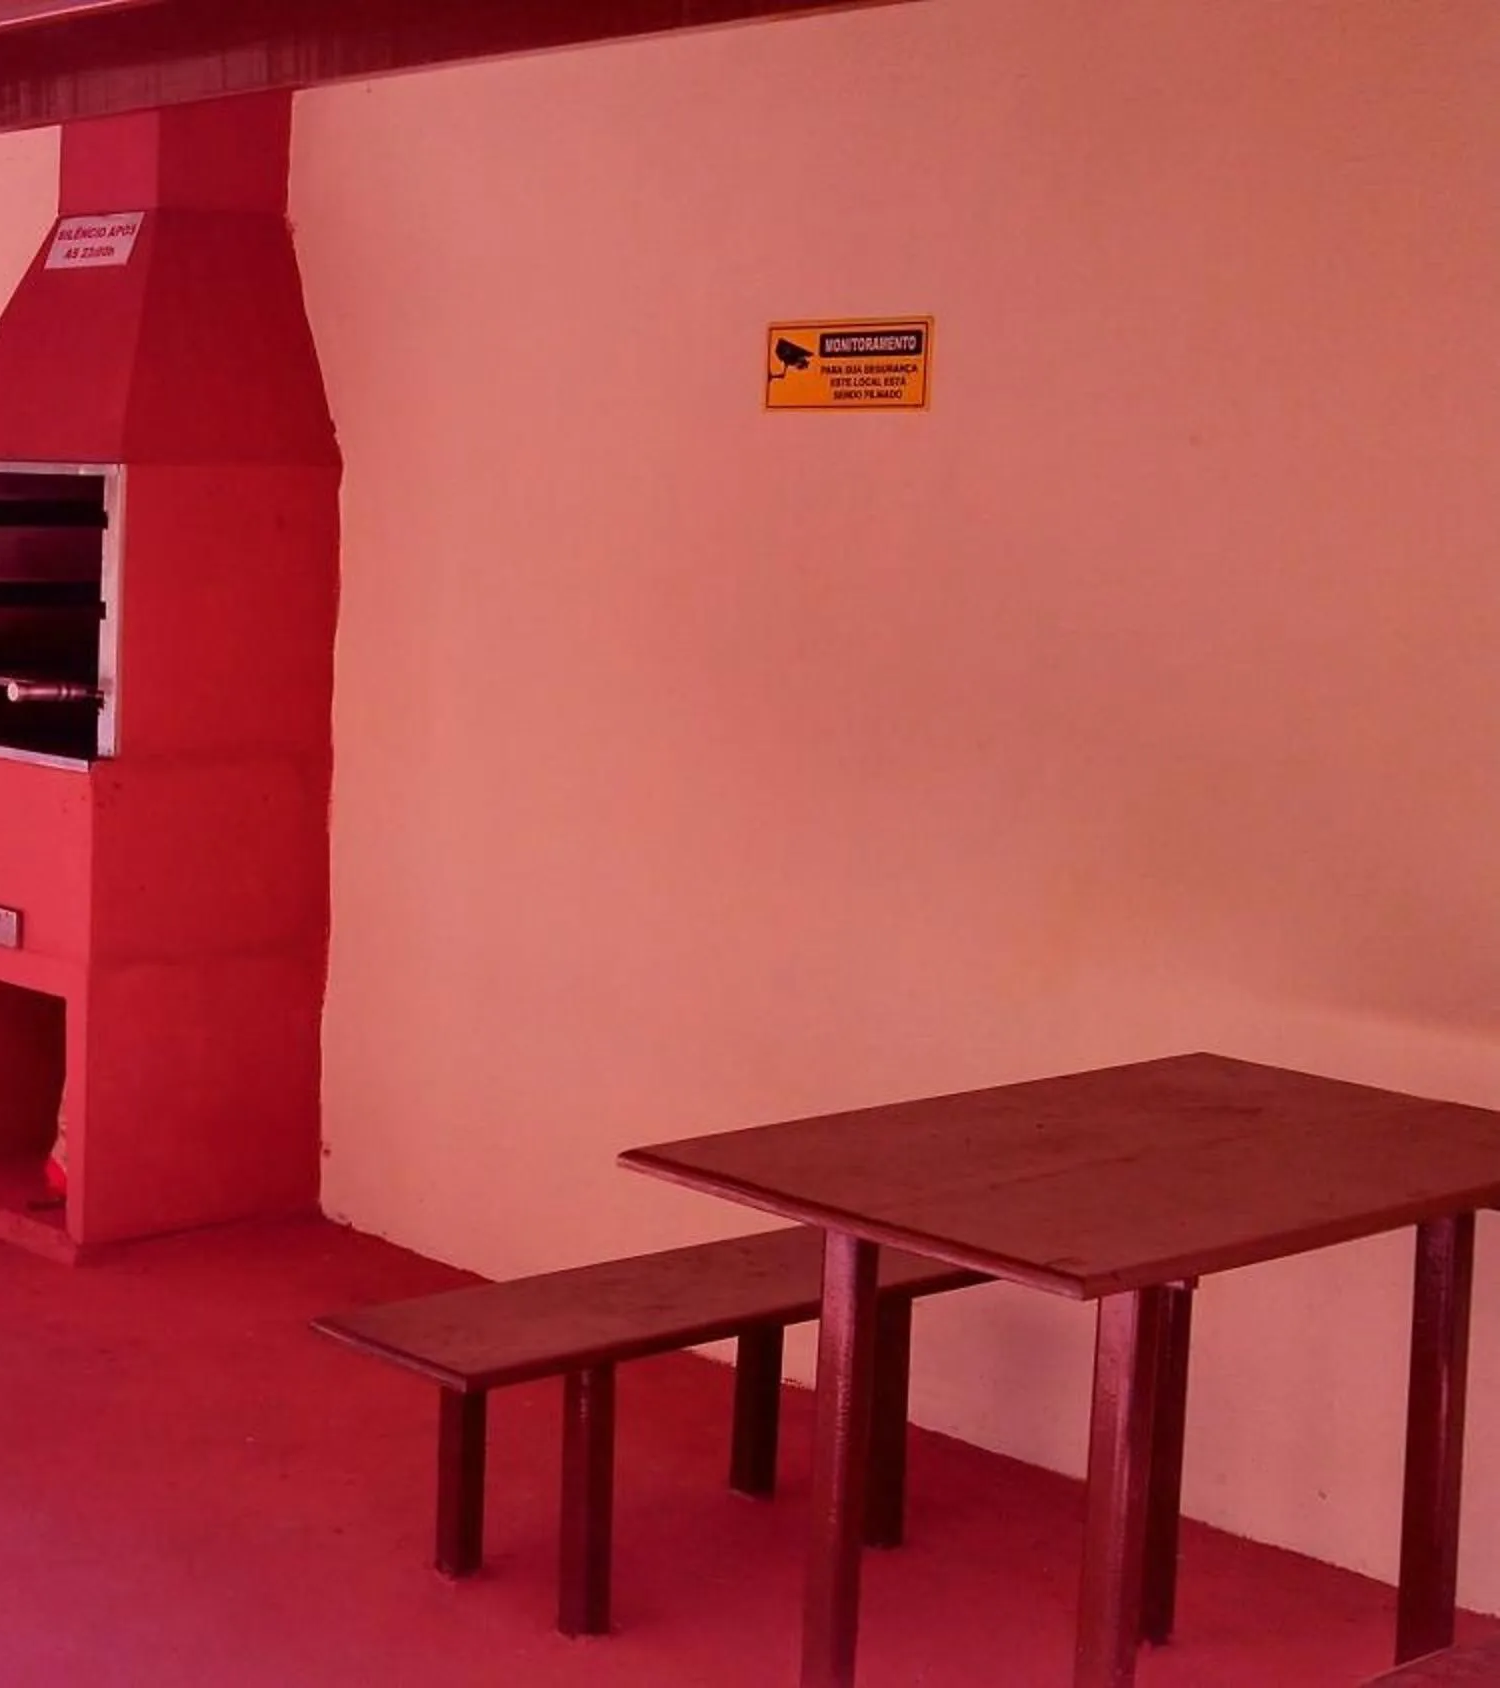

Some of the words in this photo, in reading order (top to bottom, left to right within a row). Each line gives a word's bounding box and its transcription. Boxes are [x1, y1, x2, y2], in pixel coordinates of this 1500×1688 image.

[825, 335, 917, 353] MONITORAMENTO
[821, 365, 842, 374] PARA
[830, 378, 850, 387] ESTE
[853, 377, 882, 387] LOCAL
